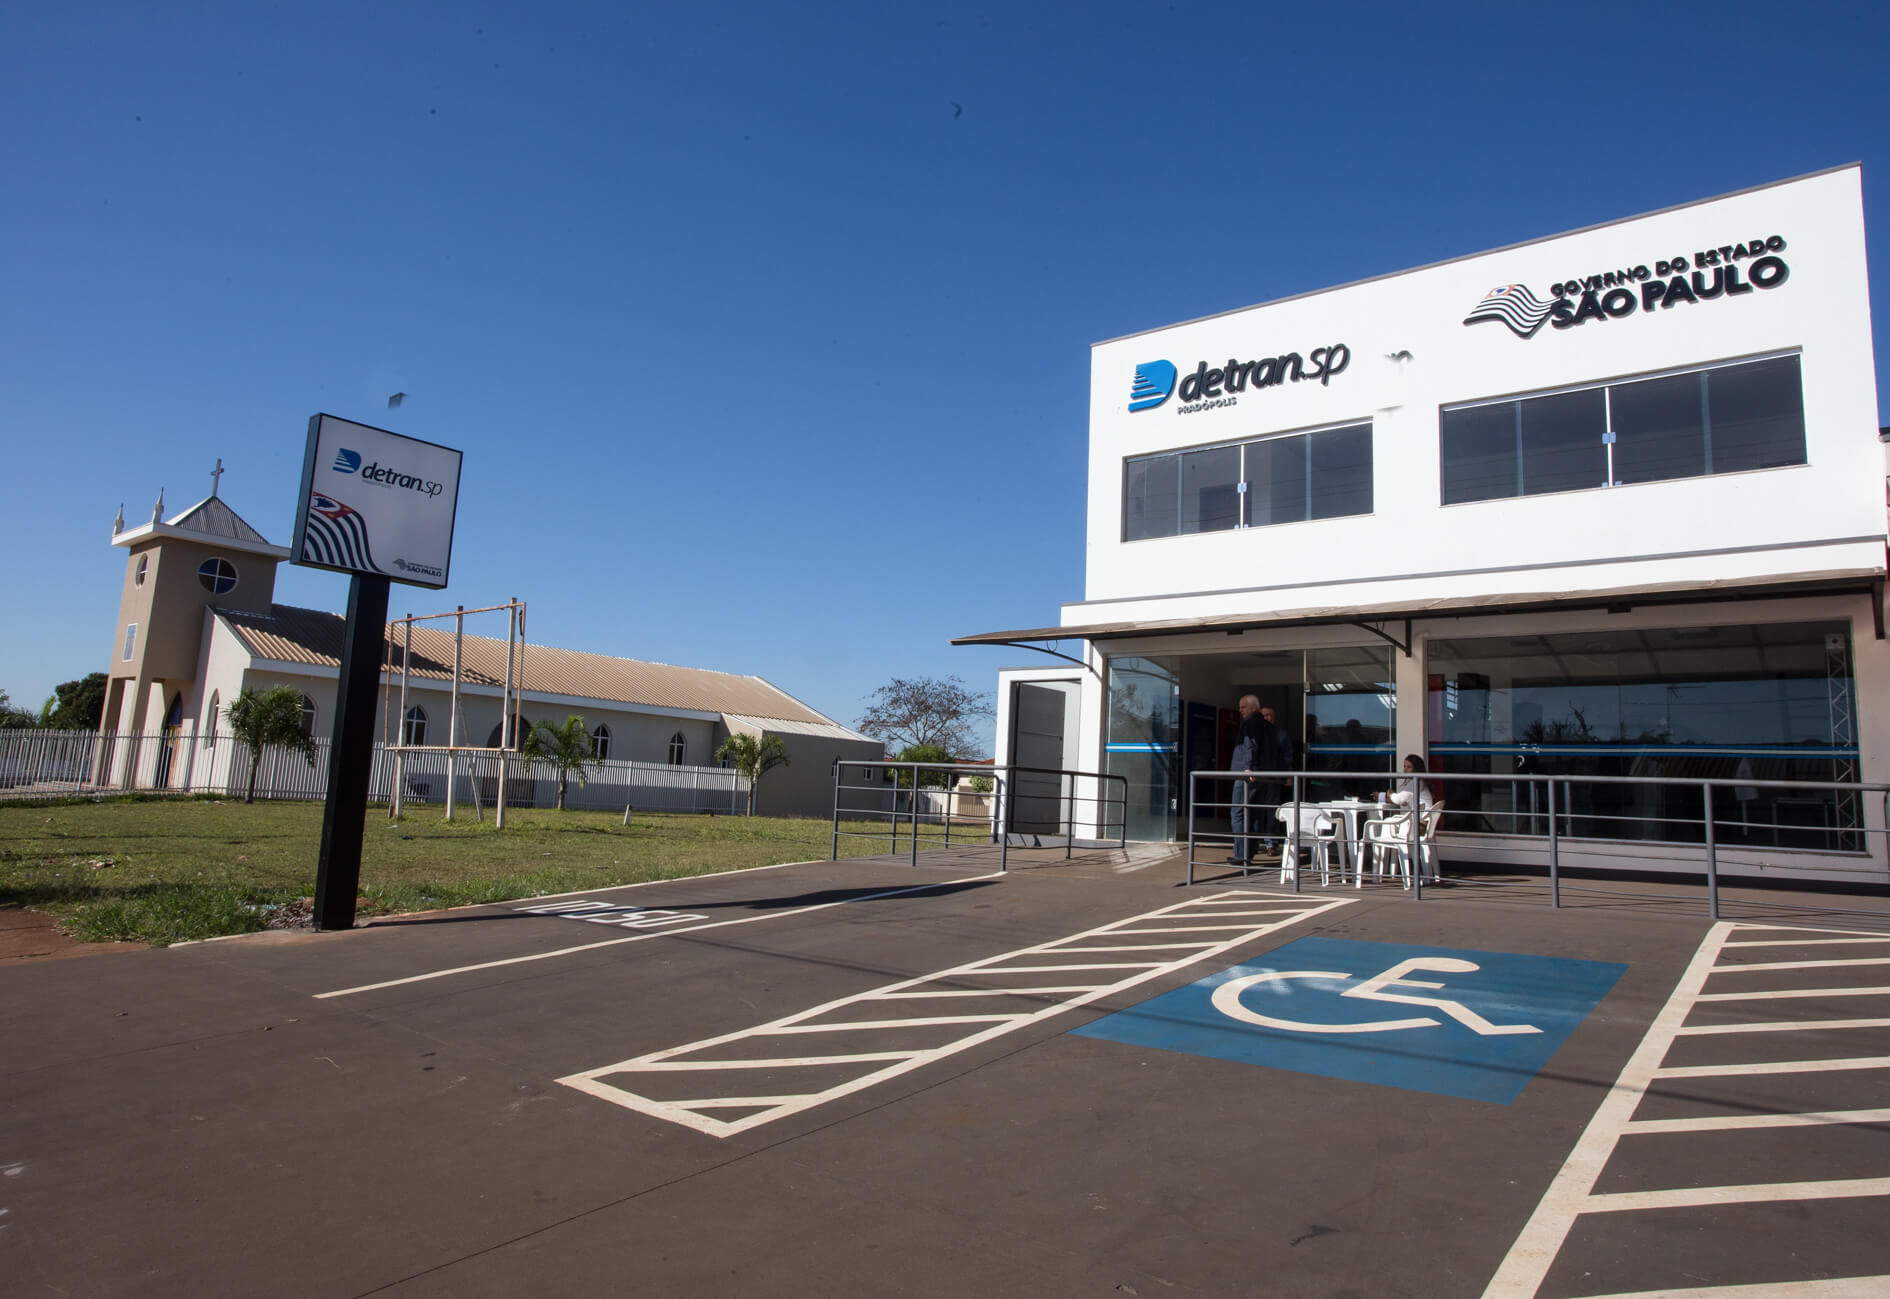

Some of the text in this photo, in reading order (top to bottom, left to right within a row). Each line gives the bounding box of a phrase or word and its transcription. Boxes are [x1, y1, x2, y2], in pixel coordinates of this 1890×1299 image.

[1550, 235, 1788, 297] GOVERNO DO ESTADO
[1551, 256, 1790, 330] SÃO PAULO
[1178, 343, 1351, 403] detran.sp
[1177, 397, 1238, 415] PRADÓPOLIS
[361, 462, 443, 499] detran.sp
